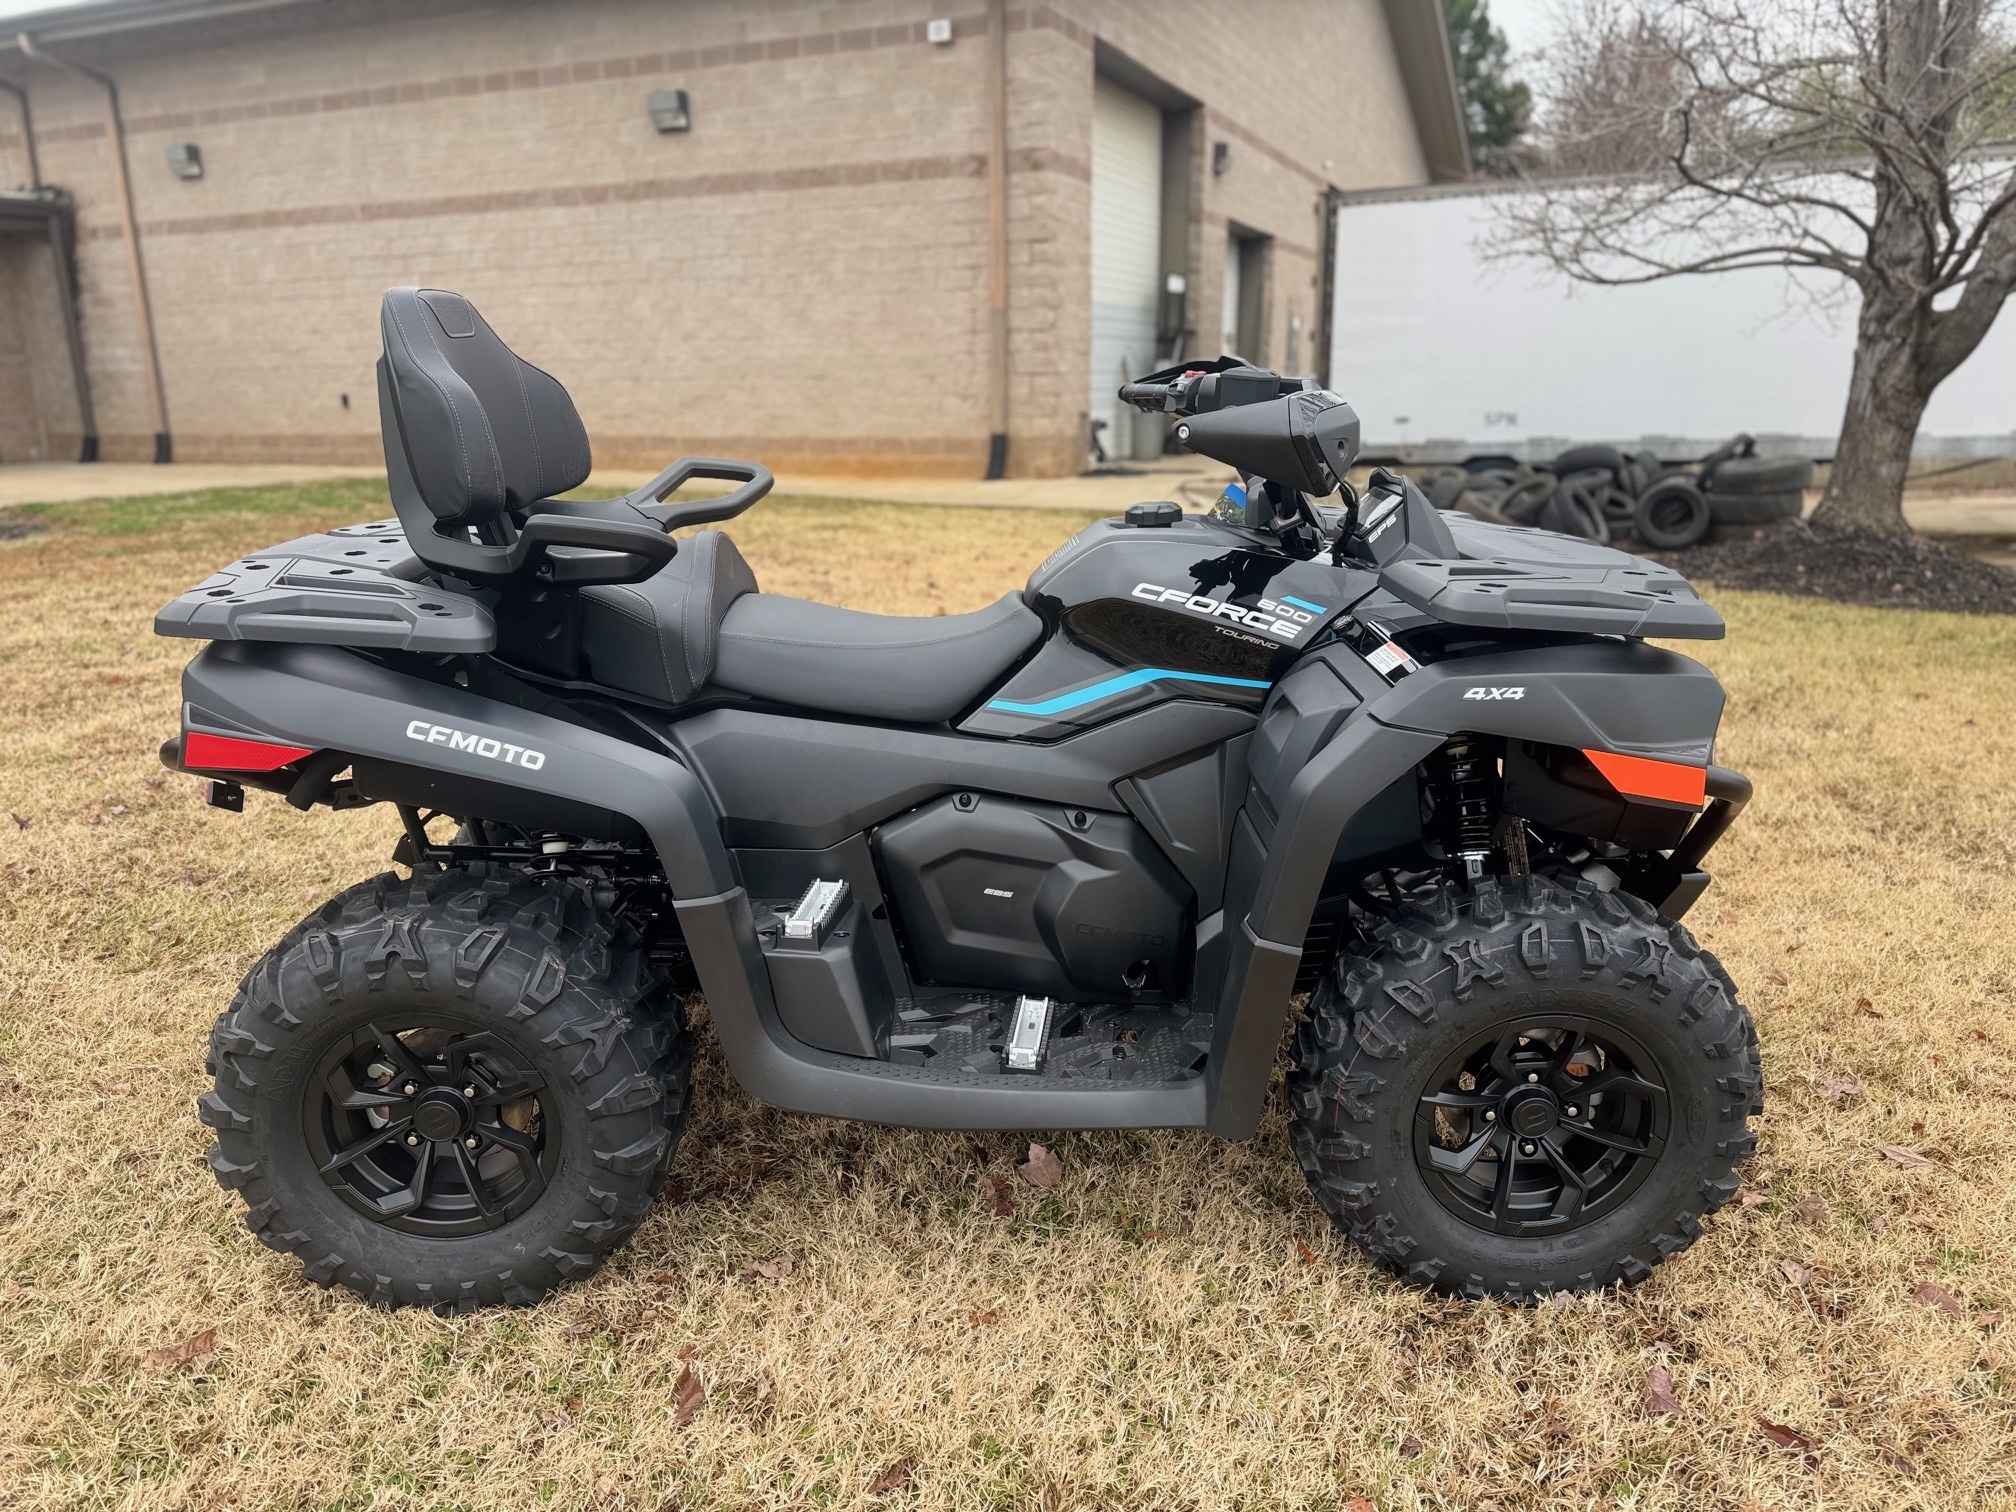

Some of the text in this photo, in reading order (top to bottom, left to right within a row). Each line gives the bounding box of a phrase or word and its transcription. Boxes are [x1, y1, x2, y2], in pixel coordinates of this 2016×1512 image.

[1368, 514, 1396, 543] EPS
[1131, 582, 1303, 639] CFORCE
[1257, 598, 1313, 624] 600
[1214, 625, 1280, 650] TOURING
[406, 720, 546, 771] CFMOTO
[984, 888, 1014, 898] EBS
[1075, 922, 1165, 946] CFMOTO
